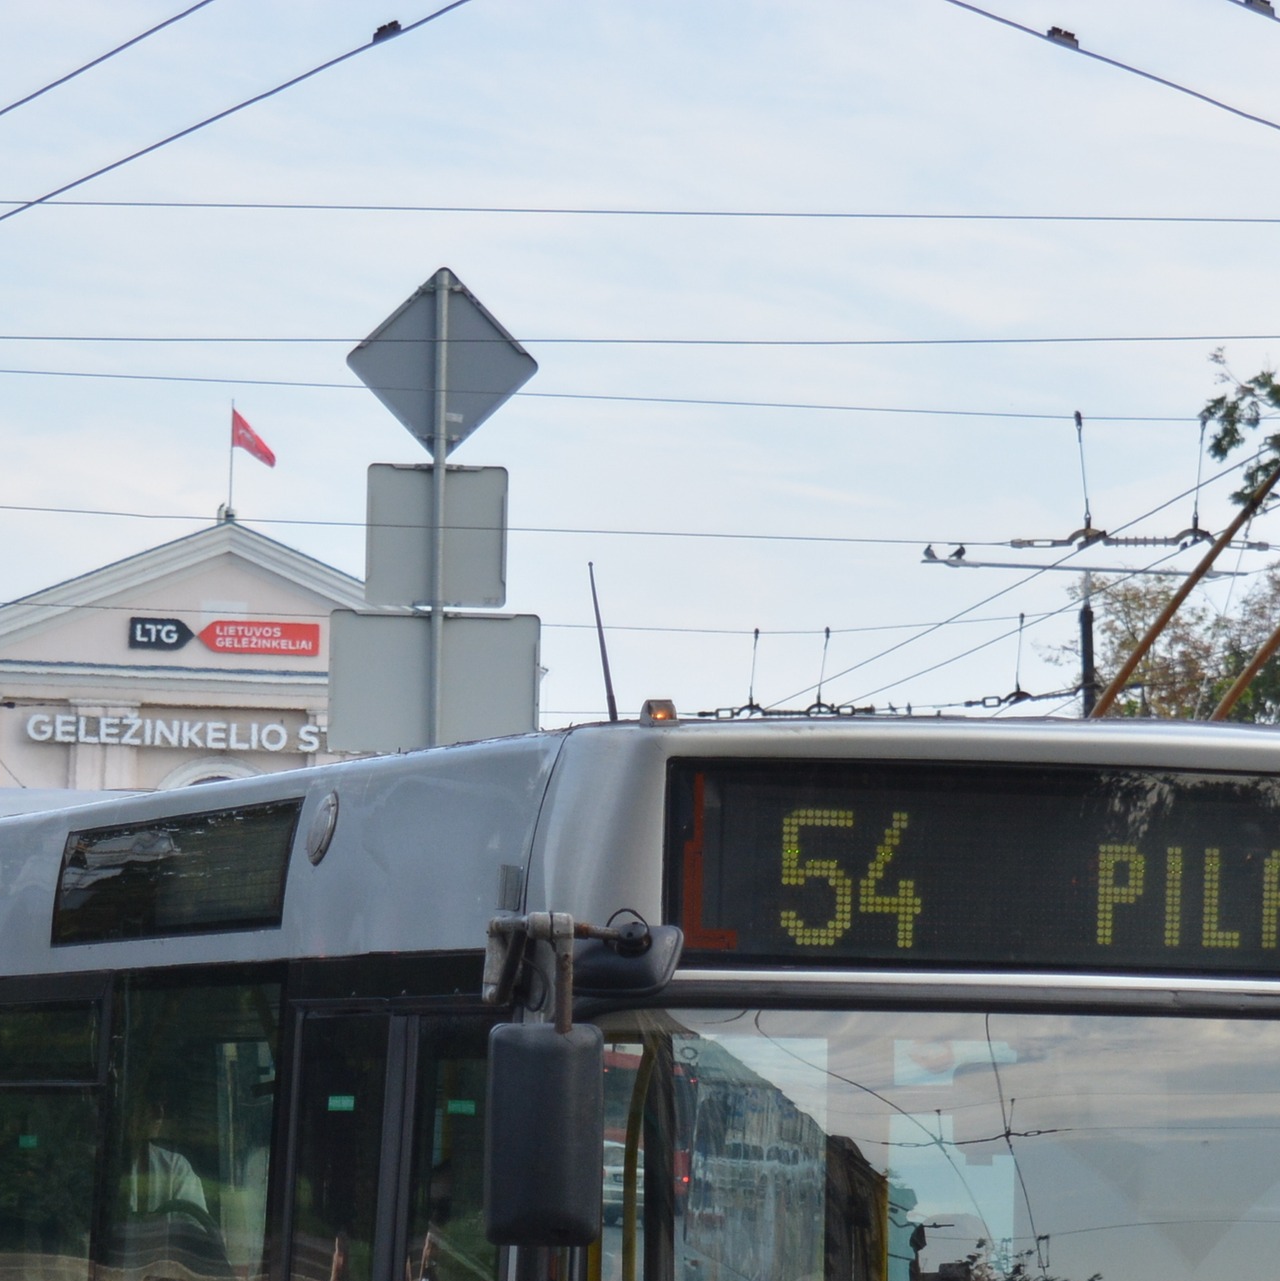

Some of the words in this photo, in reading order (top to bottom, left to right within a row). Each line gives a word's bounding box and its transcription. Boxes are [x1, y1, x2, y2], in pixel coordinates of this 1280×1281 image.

[135, 623, 178, 643] LTG
[215, 625, 282, 637] LIETUVOS
[215, 636, 313, 650] GELEŽINKELIAI
[26, 711, 288, 751] GELEŽINKELIO
[780, 809, 921, 948] 54
